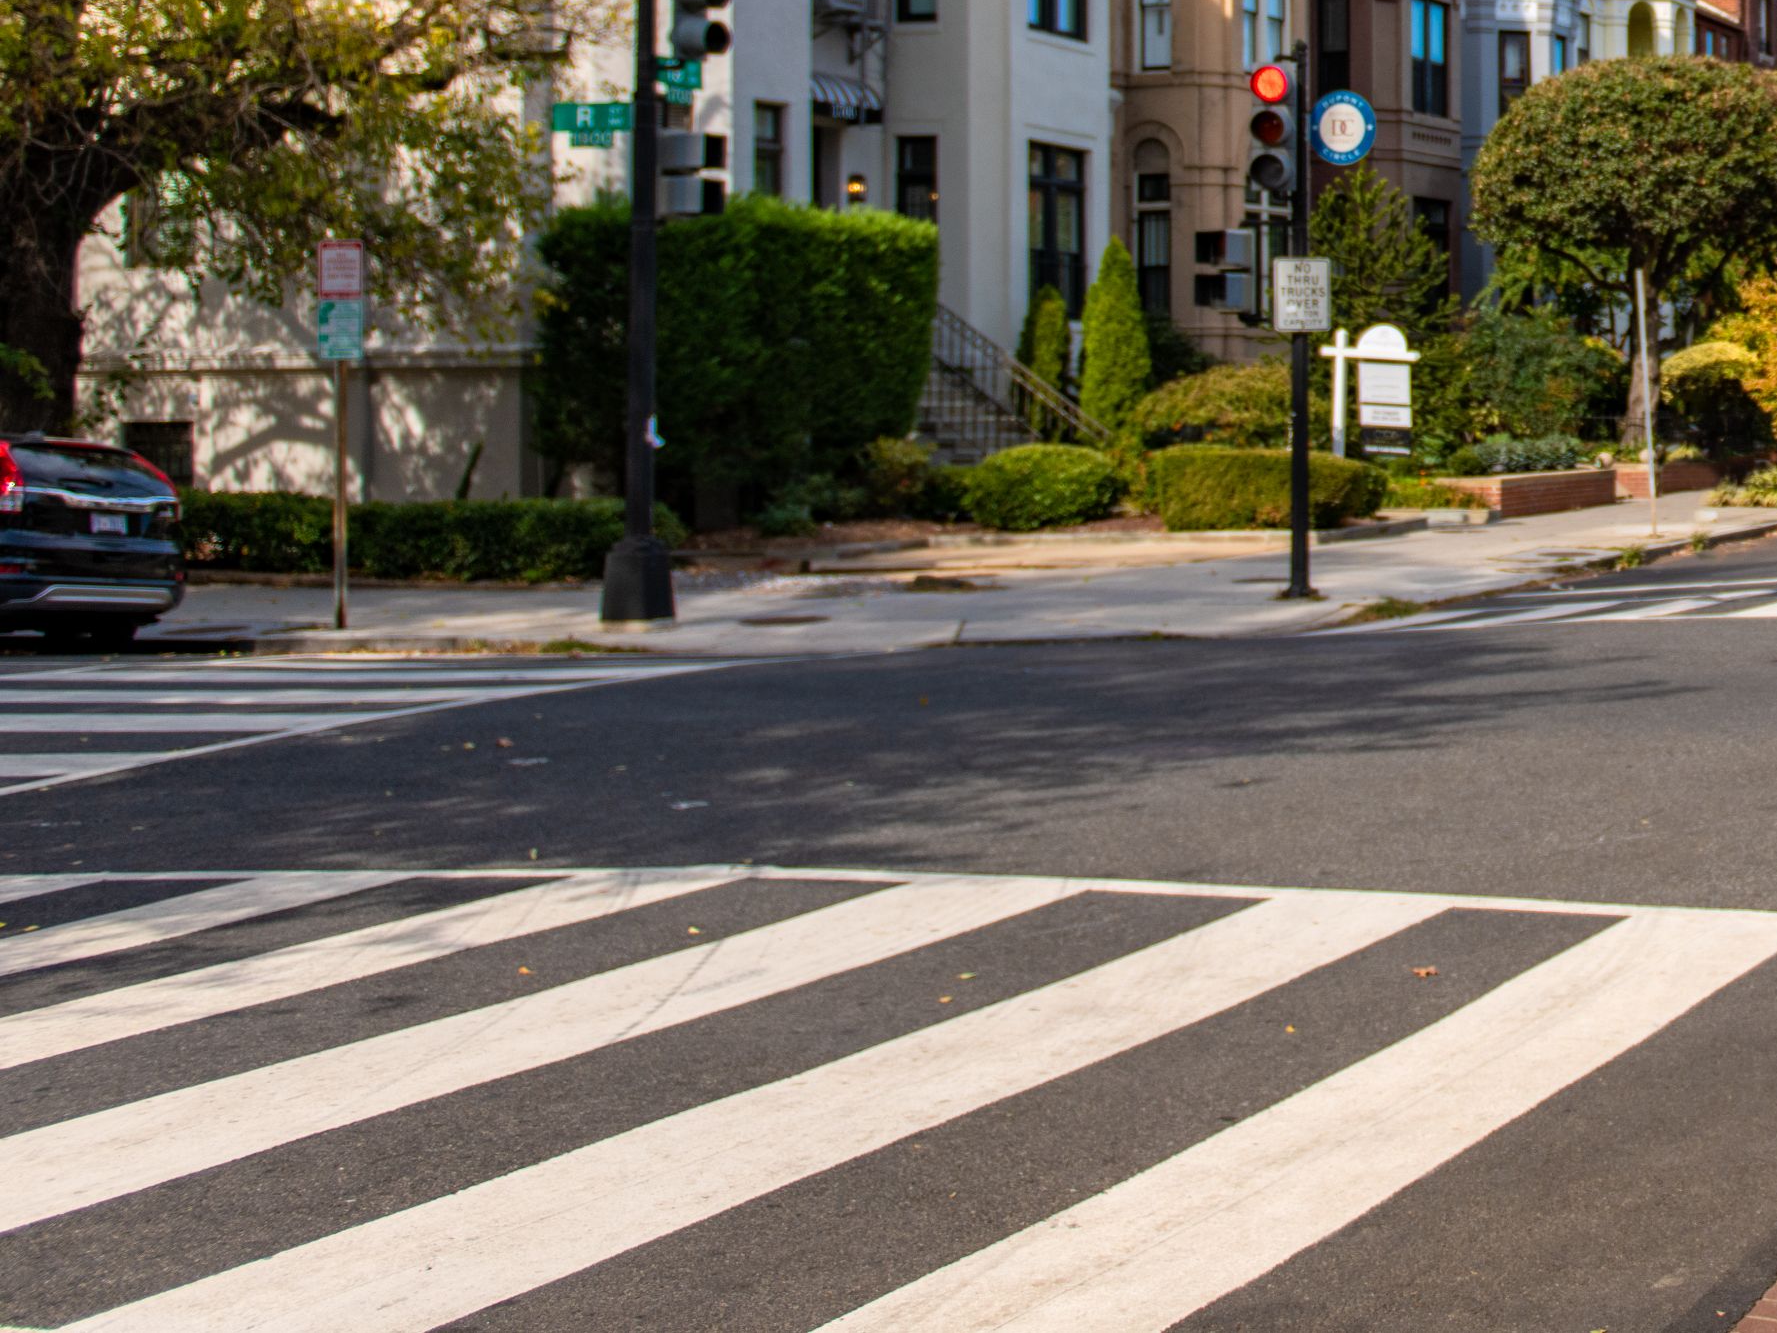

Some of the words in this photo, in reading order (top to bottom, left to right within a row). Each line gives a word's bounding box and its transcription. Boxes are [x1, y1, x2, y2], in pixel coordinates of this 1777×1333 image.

[1321, 95, 1364, 108] DUPONT
[576, 106, 594, 127] R
[1331, 119, 1355, 136] DC
[1322, 148, 1361, 161] CIRCLE
[1295, 263, 1311, 274] NO
[1287, 275, 1320, 286] THRU
[1281, 286, 1326, 298] TRUCKS
